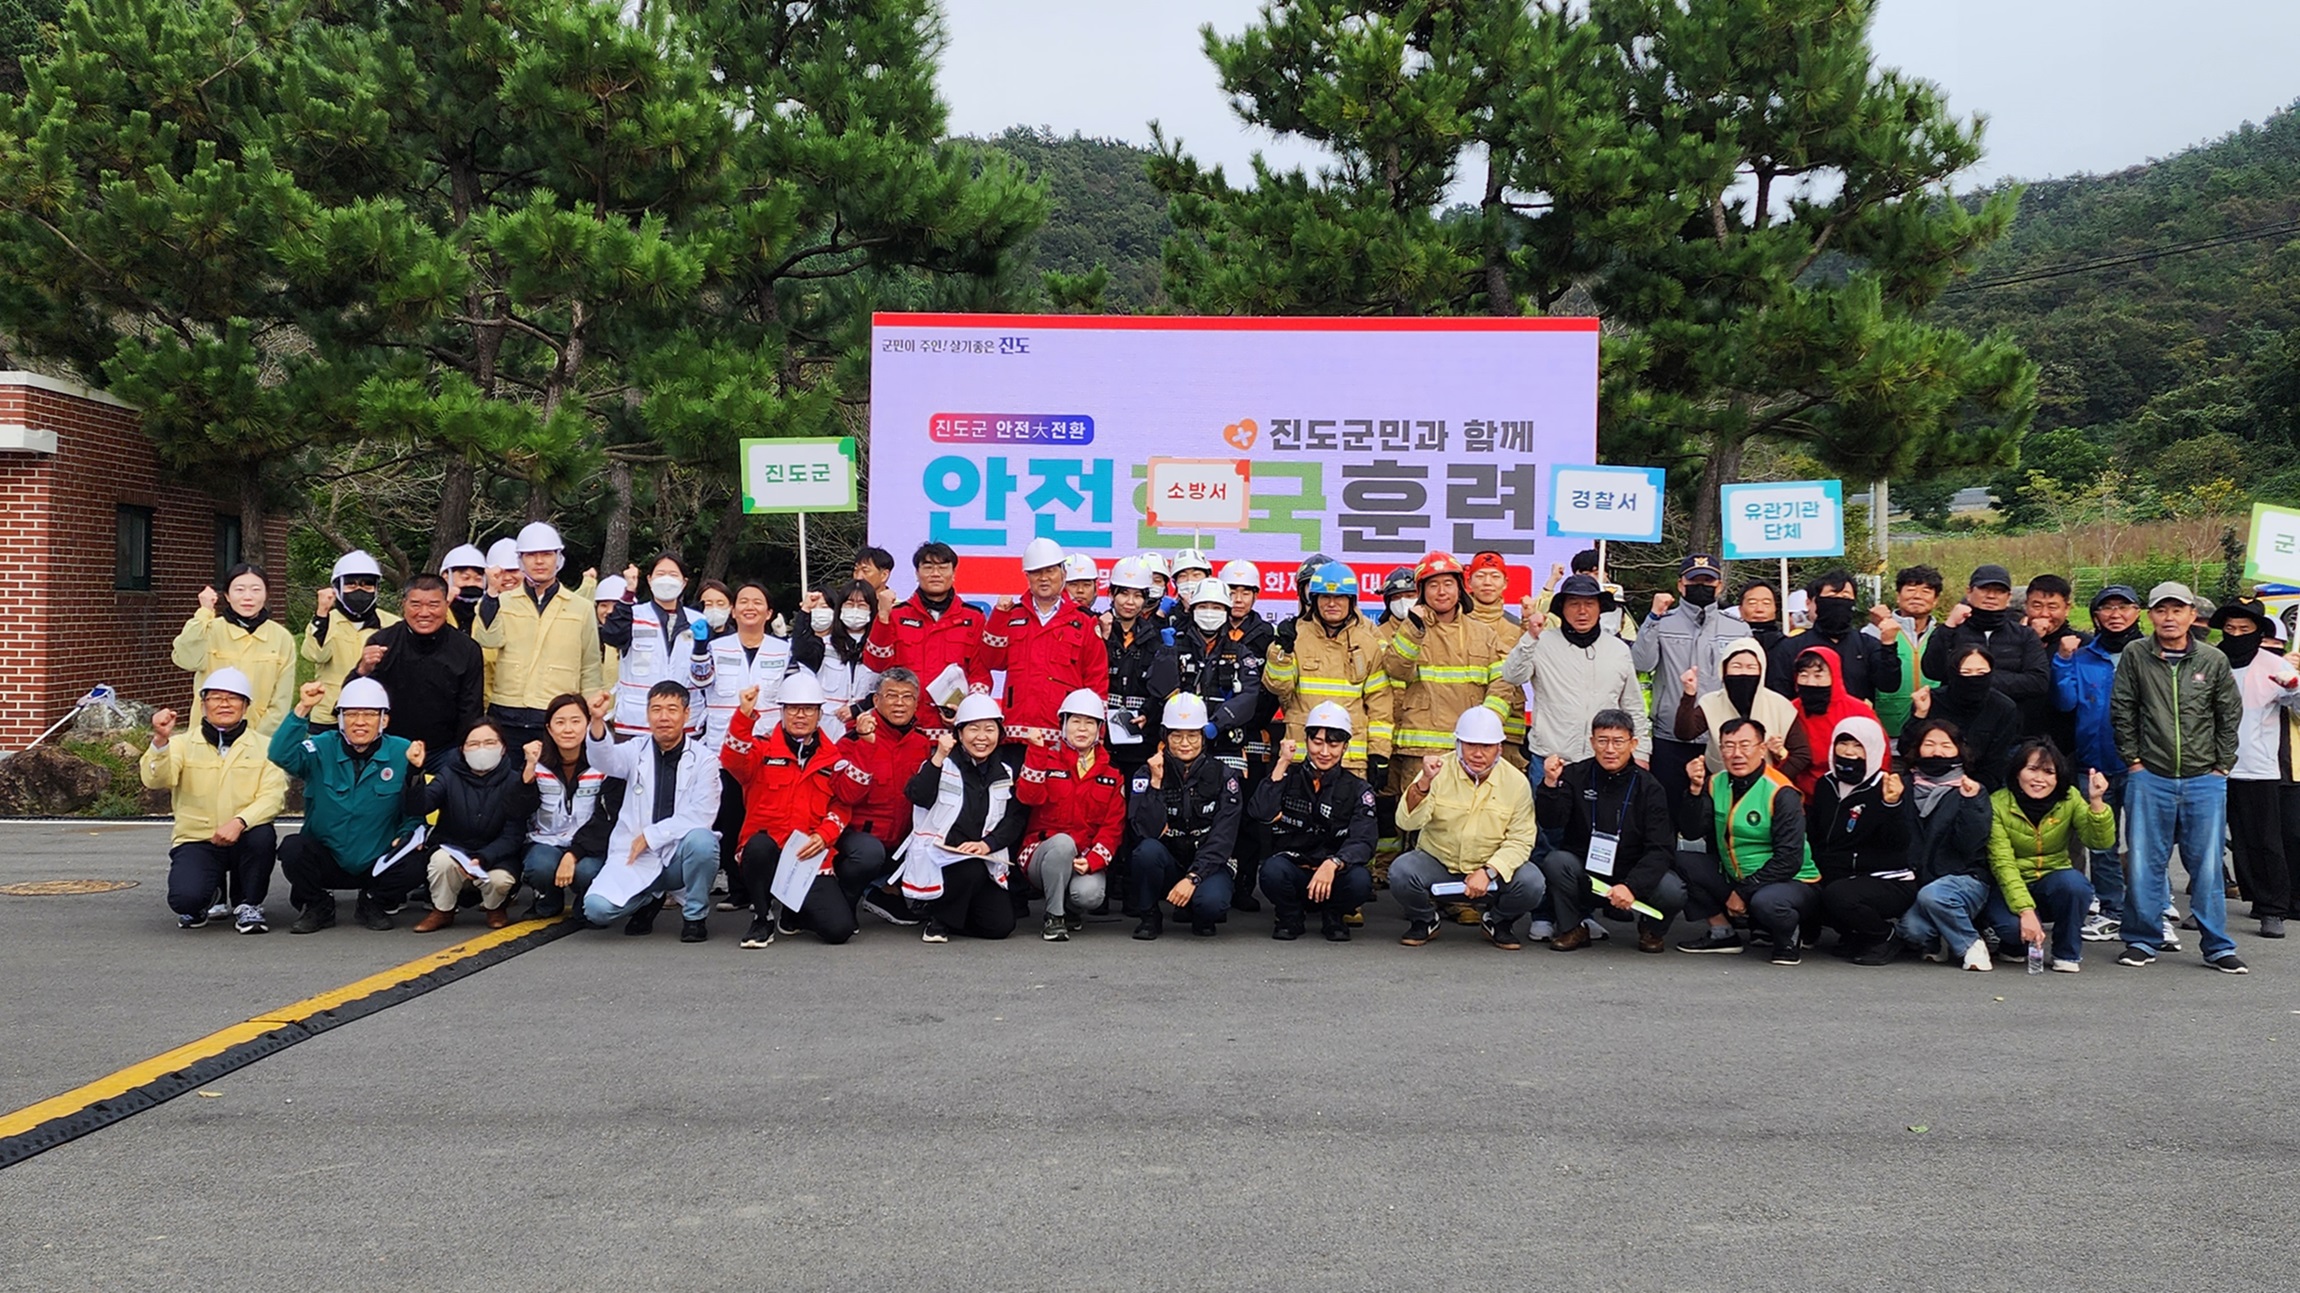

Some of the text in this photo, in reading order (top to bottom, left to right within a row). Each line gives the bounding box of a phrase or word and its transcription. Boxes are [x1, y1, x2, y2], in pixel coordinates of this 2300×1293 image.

[882, 336, 1031, 354] 군민이 주인! 살기좋은 진도
[935, 419, 1086, 439] 진도군 안전大전환
[1269, 419, 1534, 453] 진도군민과 함께
[765, 463, 831, 483] 진도군
[1167, 482, 1227, 501] 소방서
[1571, 490, 1637, 511] 경찰서
[1744, 500, 1819, 521] 유관기관
[1764, 523, 1801, 541] 단체
